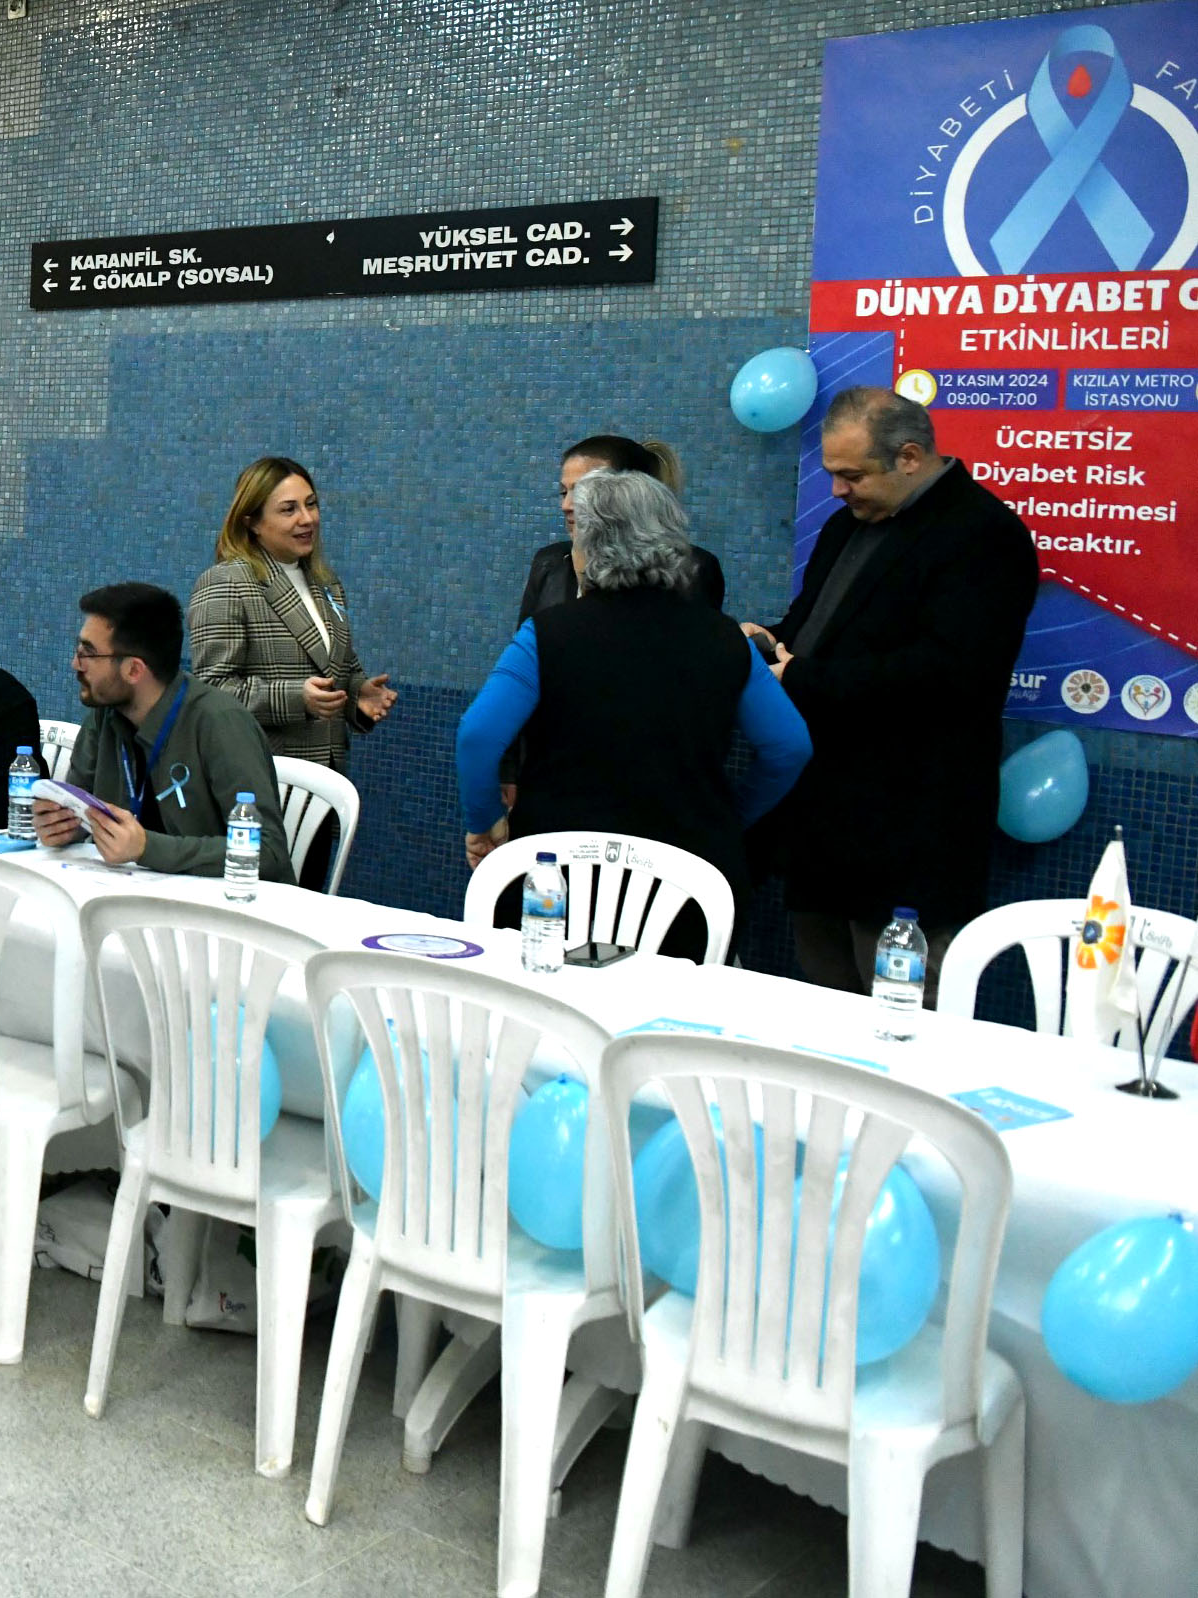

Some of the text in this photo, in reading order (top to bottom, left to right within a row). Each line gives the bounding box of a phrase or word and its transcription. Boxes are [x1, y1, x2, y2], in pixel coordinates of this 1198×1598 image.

[1156, 61, 1198, 109] FA
[419, 221, 591, 248] YÜKSEL CAD.
[71, 247, 202, 270] KARANFİL SK.
[362, 247, 590, 278] MEŞRUTİYET CAD.
[70, 265, 273, 291] Z. GÖKALP (SOYSAL)
[855, 280, 984, 317] DÜNYA
[993, 274, 1171, 315] DİYABET
[960, 320, 1170, 352] ETKİNLİKLERİ
[939, 374, 1049, 387] 12 KASIM 2024
[1073, 374, 1194, 387] KIZILAY METRO
[1085, 391, 1179, 407] İSTASYONU
[996, 425, 1133, 451] ÜCRETSİZ
[972, 461, 1146, 486] Diyabet Risk
[1003, 496, 1177, 522] erlendirmesi
[1030, 530, 1142, 555] lacaktır.
[1010, 672, 1048, 689] sur
